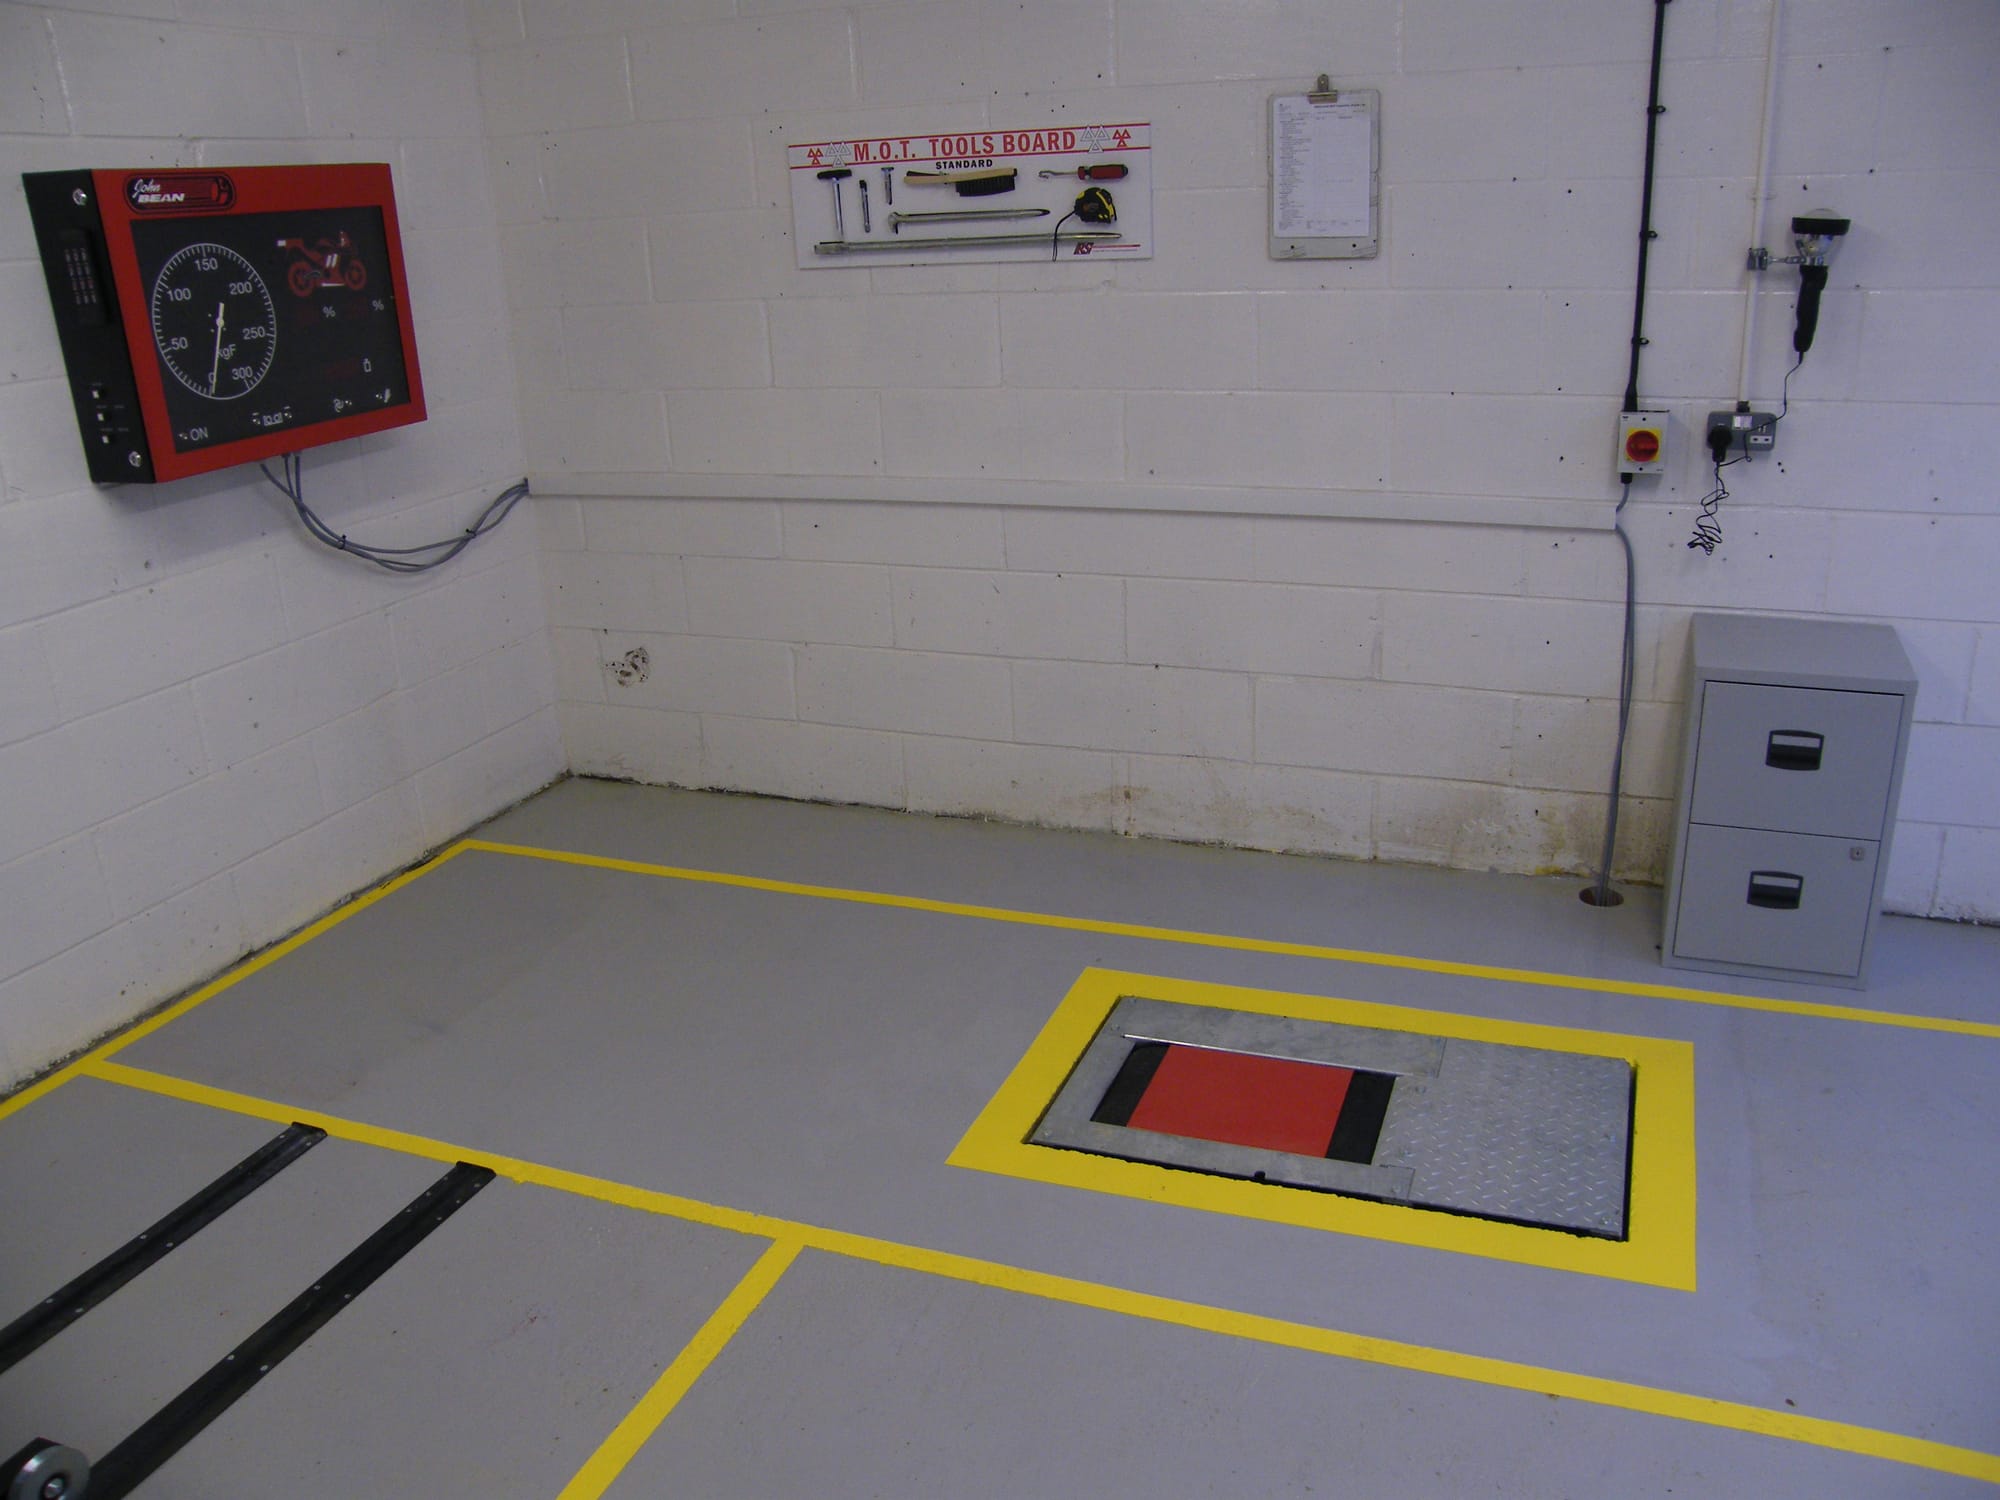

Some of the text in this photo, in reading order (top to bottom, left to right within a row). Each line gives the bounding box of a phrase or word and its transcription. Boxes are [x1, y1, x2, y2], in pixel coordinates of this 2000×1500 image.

[853, 130, 1076, 161] M.O.T. TOOLS BOARD
[935, 158, 993, 170] STANDARD
[132, 179, 160, 199] John
[138, 193, 185, 203] BEAN
[194, 257, 218, 271] 150
[166, 287, 192, 301] 100
[229, 281, 253, 295] 200
[242, 326, 266, 340] 250
[171, 337, 189, 350] 50
[231, 366, 253, 380] 300
[190, 426, 209, 440] ON
